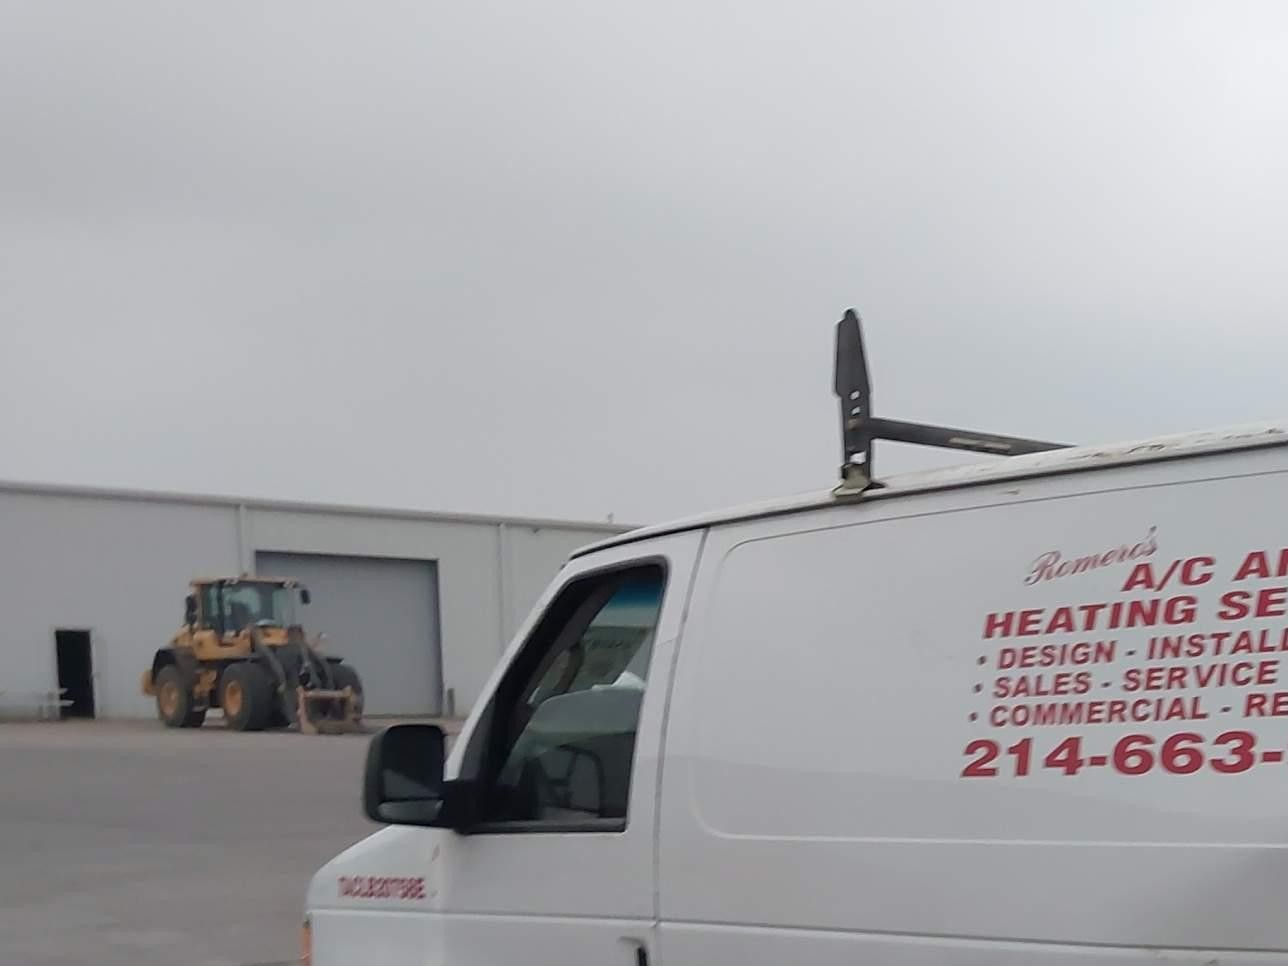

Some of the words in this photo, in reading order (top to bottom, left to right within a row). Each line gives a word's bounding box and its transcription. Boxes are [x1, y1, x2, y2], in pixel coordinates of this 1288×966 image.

[1024, 526, 1159, 585] Romero's
[1122, 555, 1215, 593] A/C
[983, 594, 1199, 639] HEATING
[997, 640, 1117, 671] DESIGN
[992, 671, 1092, 699] SALES
[1122, 660, 1279, 693] SERVICE
[990, 697, 1209, 728] COMMERCIAL
